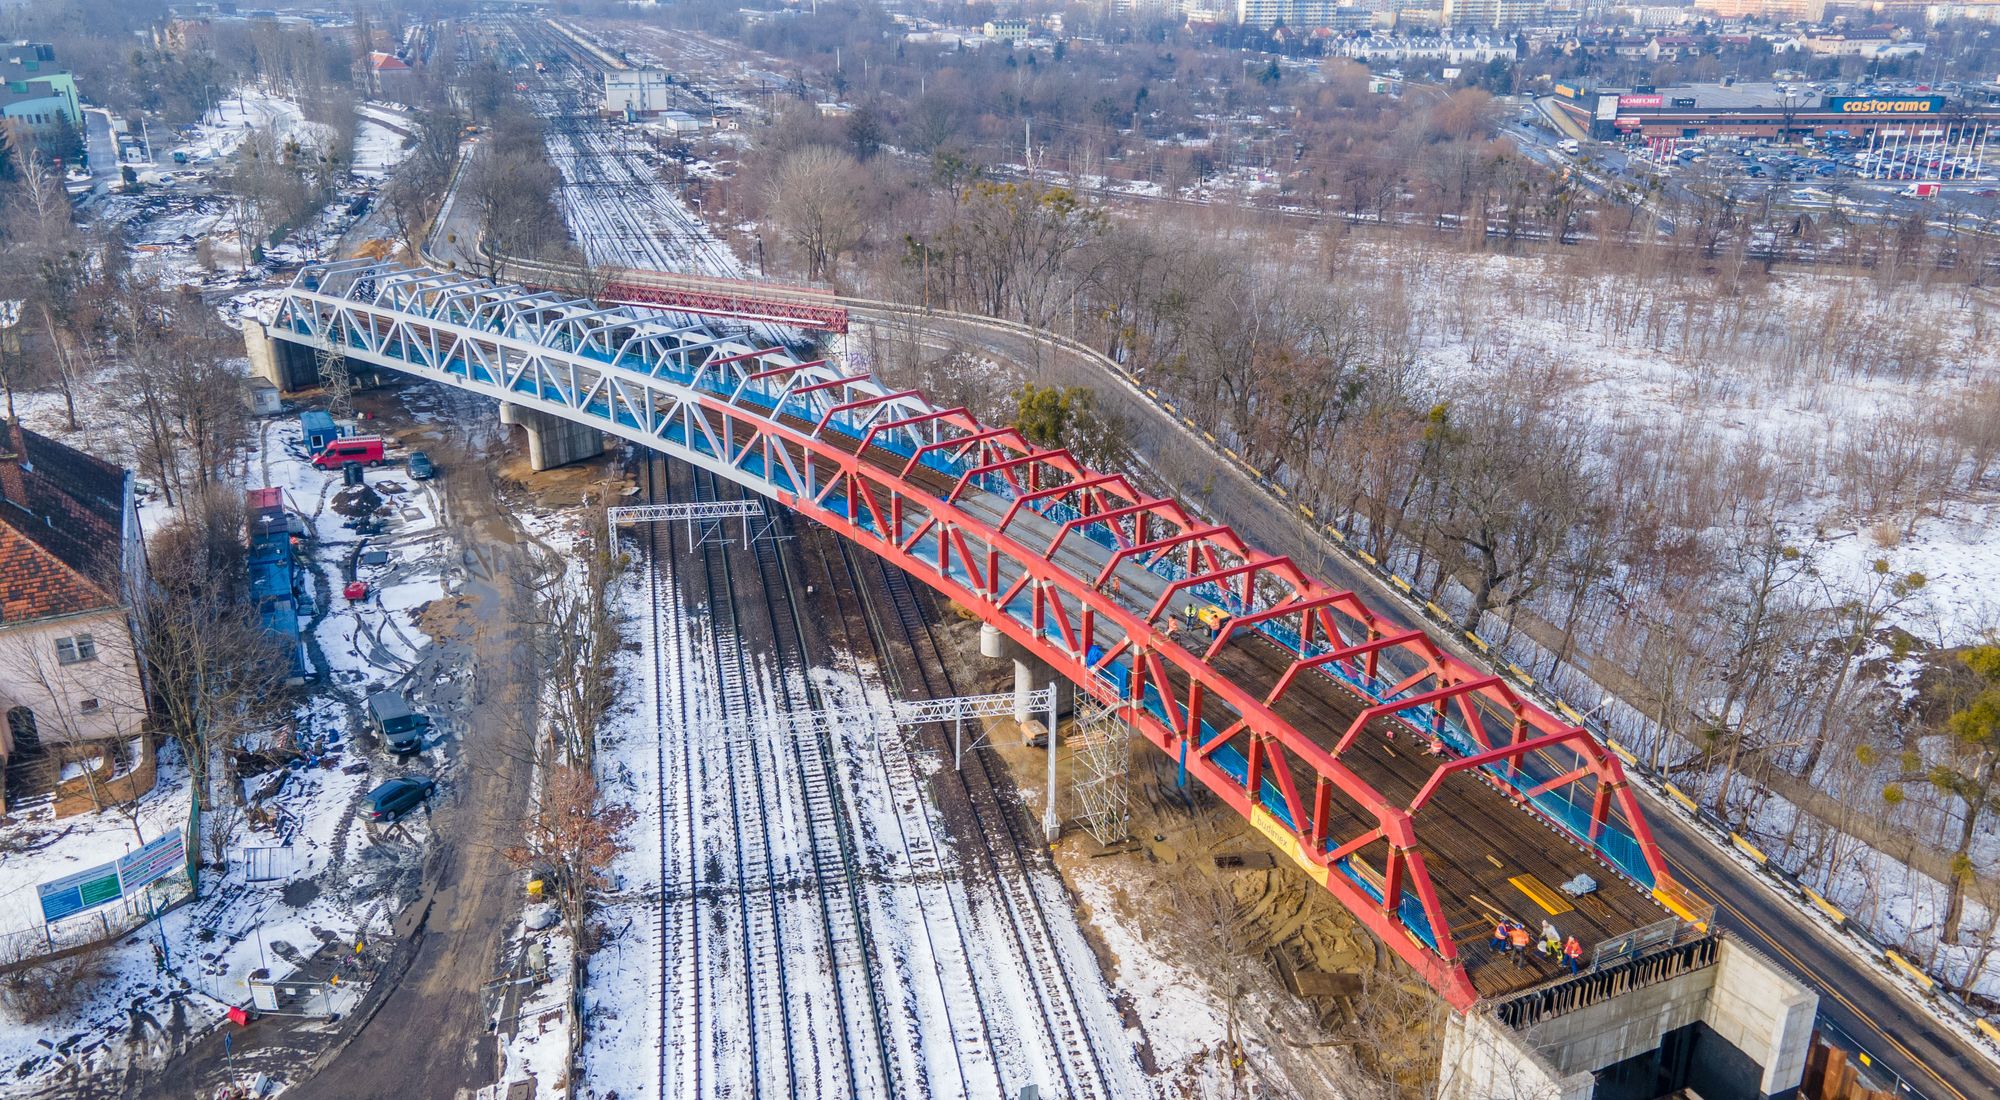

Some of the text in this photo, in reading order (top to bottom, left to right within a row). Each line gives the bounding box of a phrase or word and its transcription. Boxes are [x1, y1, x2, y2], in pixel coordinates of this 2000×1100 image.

[1620, 97, 1661, 105] KOMFORT
[1843, 99, 1931, 112] castorama
[1256, 815, 1288, 849] budimex
